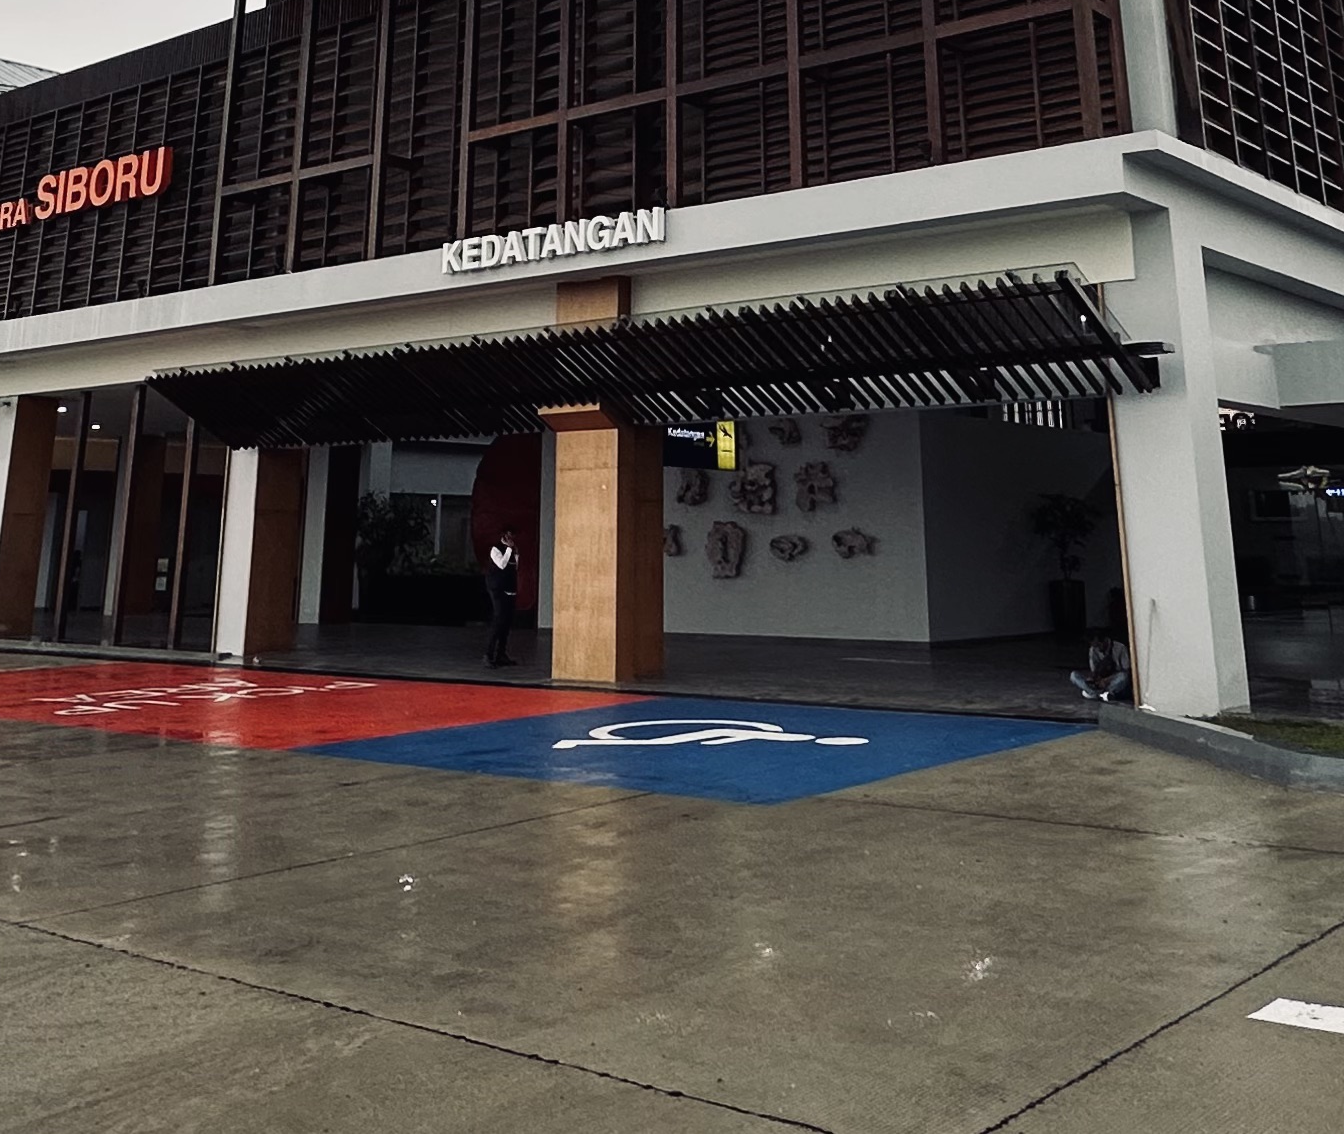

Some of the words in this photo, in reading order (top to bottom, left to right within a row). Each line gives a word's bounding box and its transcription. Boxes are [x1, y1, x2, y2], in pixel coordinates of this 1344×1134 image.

[34, 146, 172, 220] SIBORU
[442, 207, 665, 274] KEDATANGAN
[28, 677, 258, 703] AREA
[175, 680, 379, 703] PICK
[54, 699, 182, 716] UP
